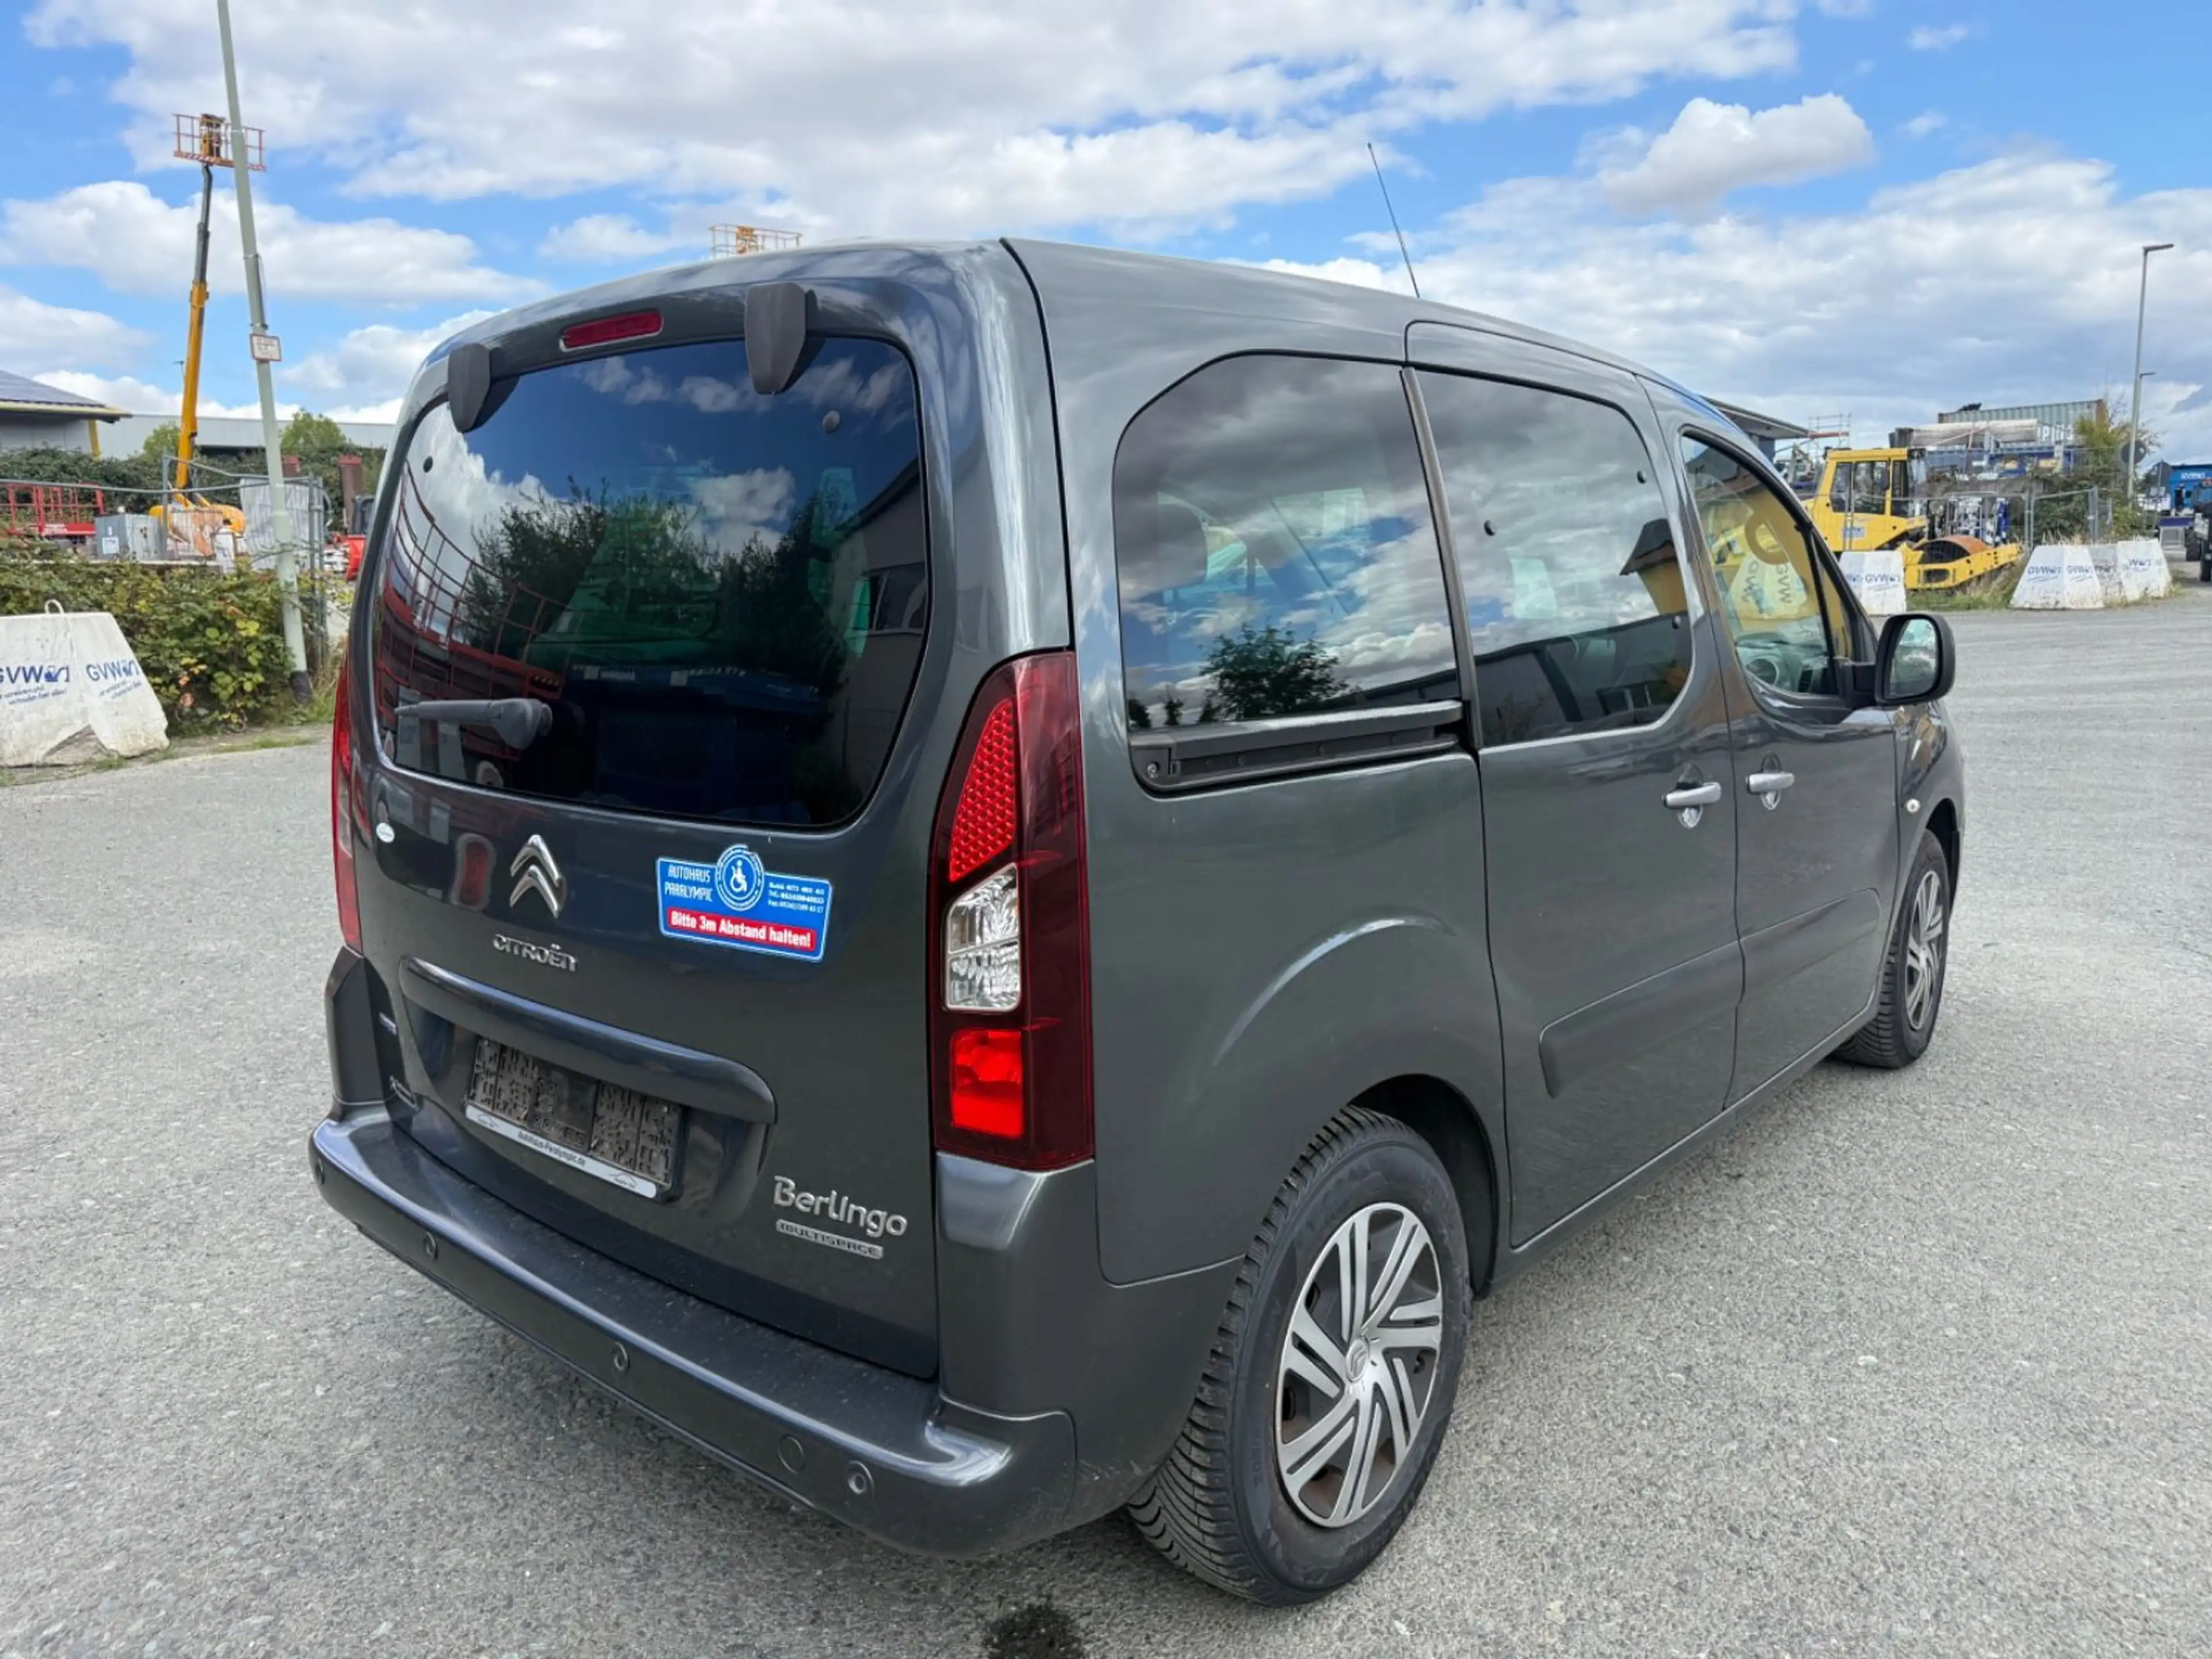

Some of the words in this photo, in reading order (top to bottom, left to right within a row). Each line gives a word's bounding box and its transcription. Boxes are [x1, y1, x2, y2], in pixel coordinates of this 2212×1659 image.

[86, 660, 122, 682] GVW
[668, 864, 711, 882] AUTOHAUS
[664, 881, 713, 903] PARALYMPIC
[671, 911, 697, 929] Bitte
[699, 915, 717, 932] 3m
[719, 918, 767, 940] Abstand
[768, 926, 812, 948] halten!
[493, 933, 578, 972] CITROËN
[774, 1175, 908, 1238] Berlingo
[779, 1222, 878, 1256] MULTISPACE
